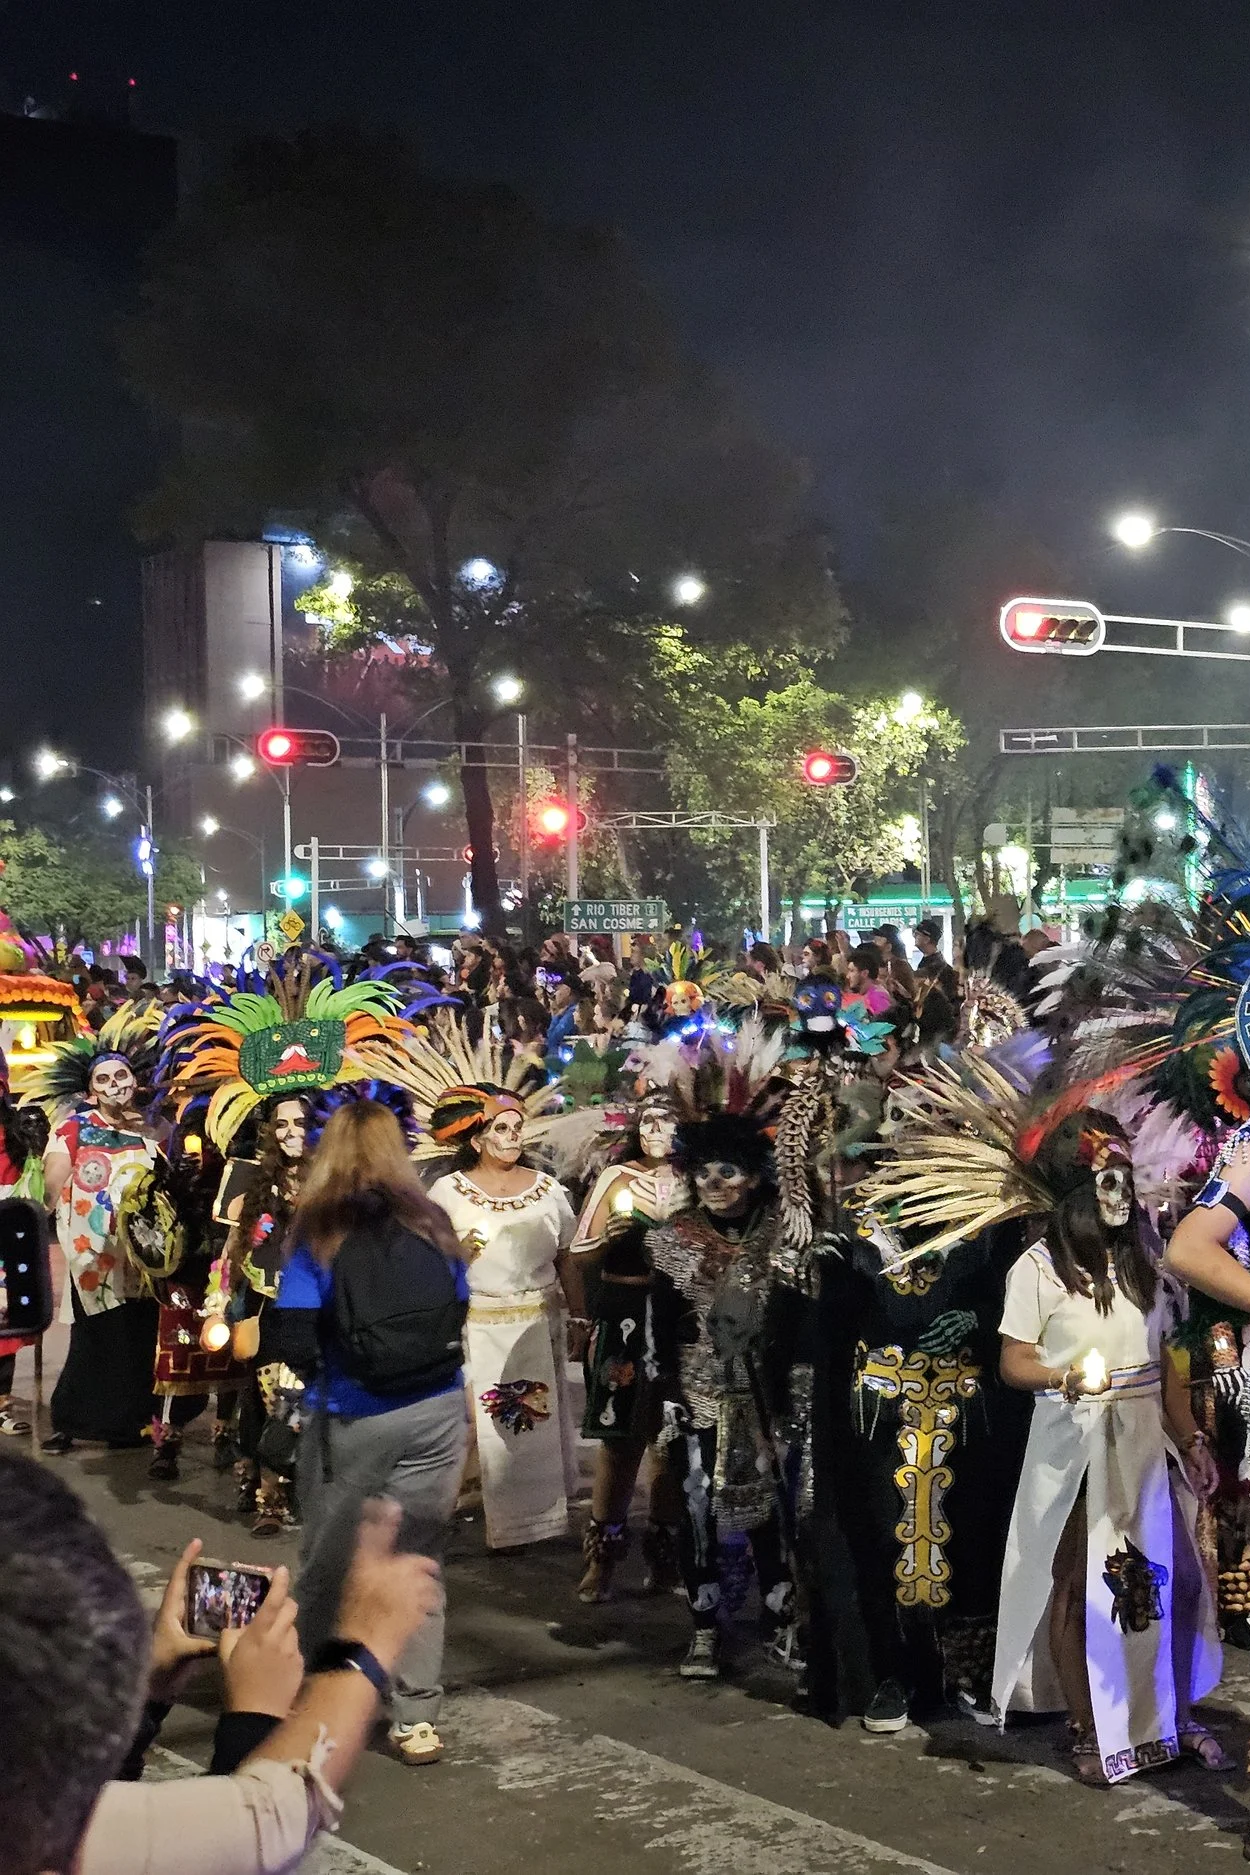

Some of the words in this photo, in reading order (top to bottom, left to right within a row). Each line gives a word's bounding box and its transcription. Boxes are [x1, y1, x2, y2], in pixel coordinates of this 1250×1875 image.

[586, 903, 605, 916] RIO
[610, 903, 640, 916] TIBER
[570, 918, 598, 930] SAN
[603, 917, 644, 930] COSME
[848, 918, 876, 928] CALLE
